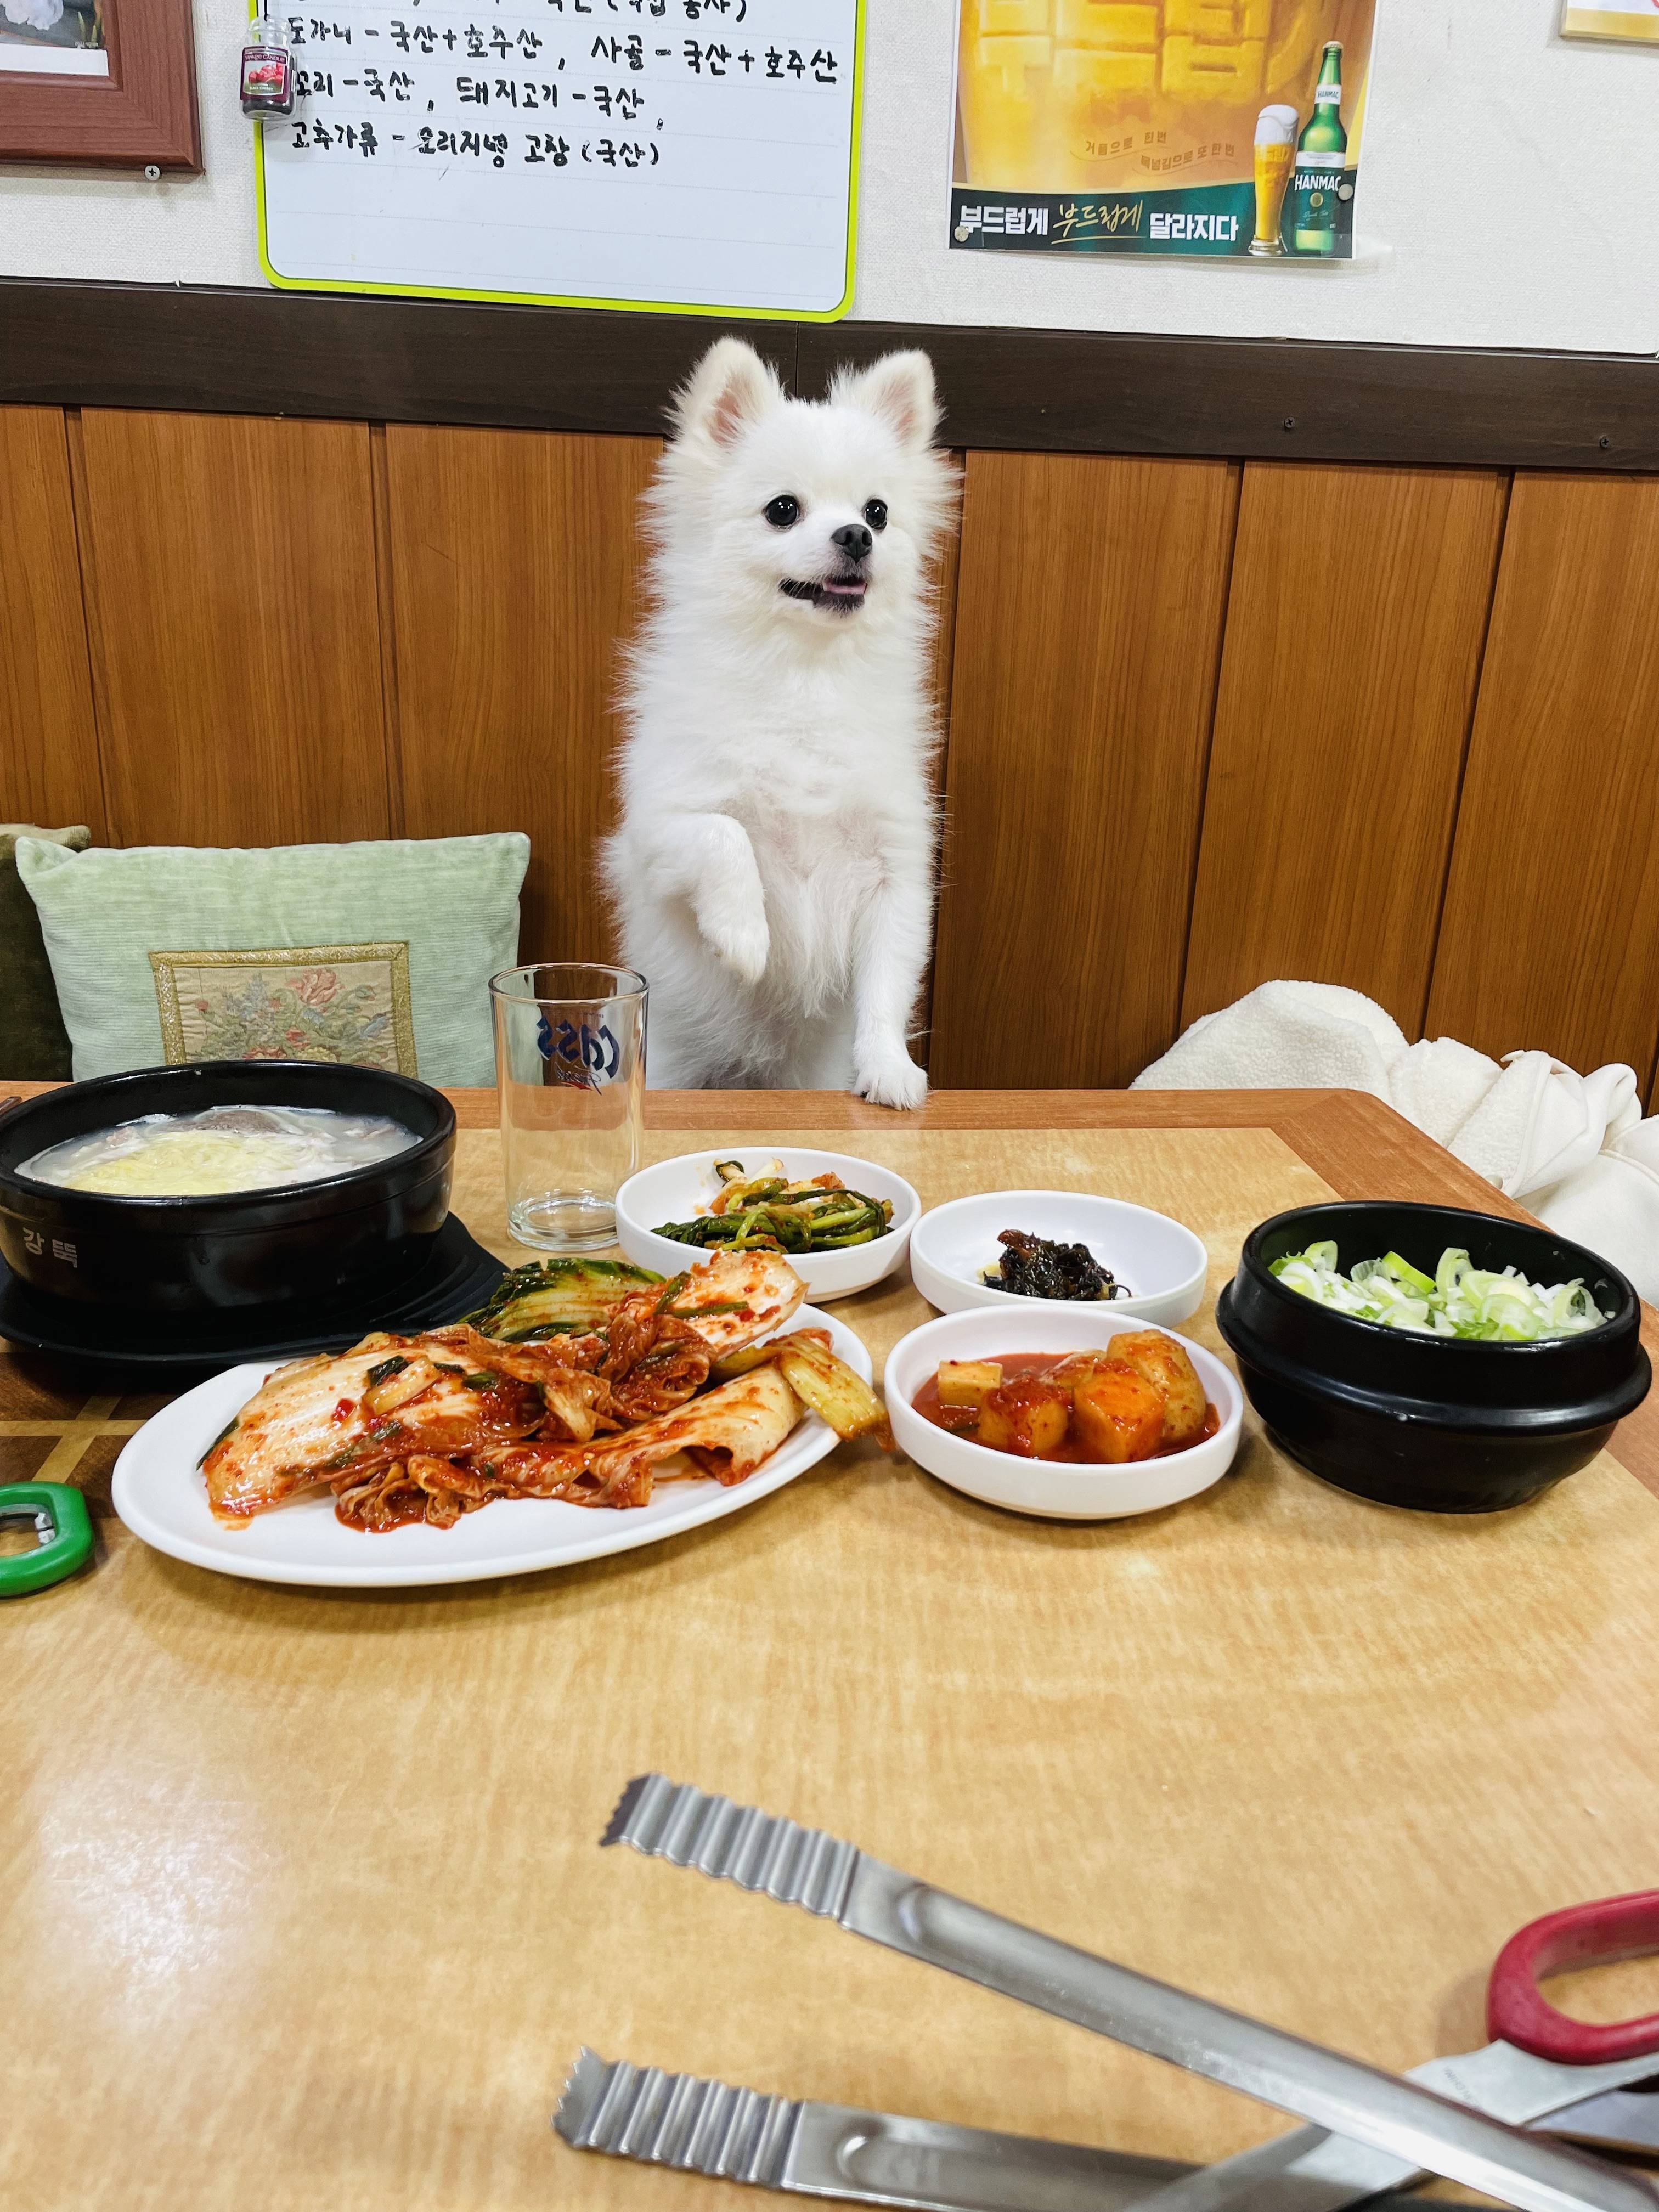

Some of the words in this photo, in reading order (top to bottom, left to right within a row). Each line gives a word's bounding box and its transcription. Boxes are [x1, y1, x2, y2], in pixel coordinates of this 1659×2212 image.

[591, 35, 644, 70] 사골
[456, 77, 557, 108] 돼지고기
[1294, 174, 1342, 191] HANMAC
[959, 205, 1048, 236] 부드럽게
[1149, 212, 1239, 241] 달라지다
